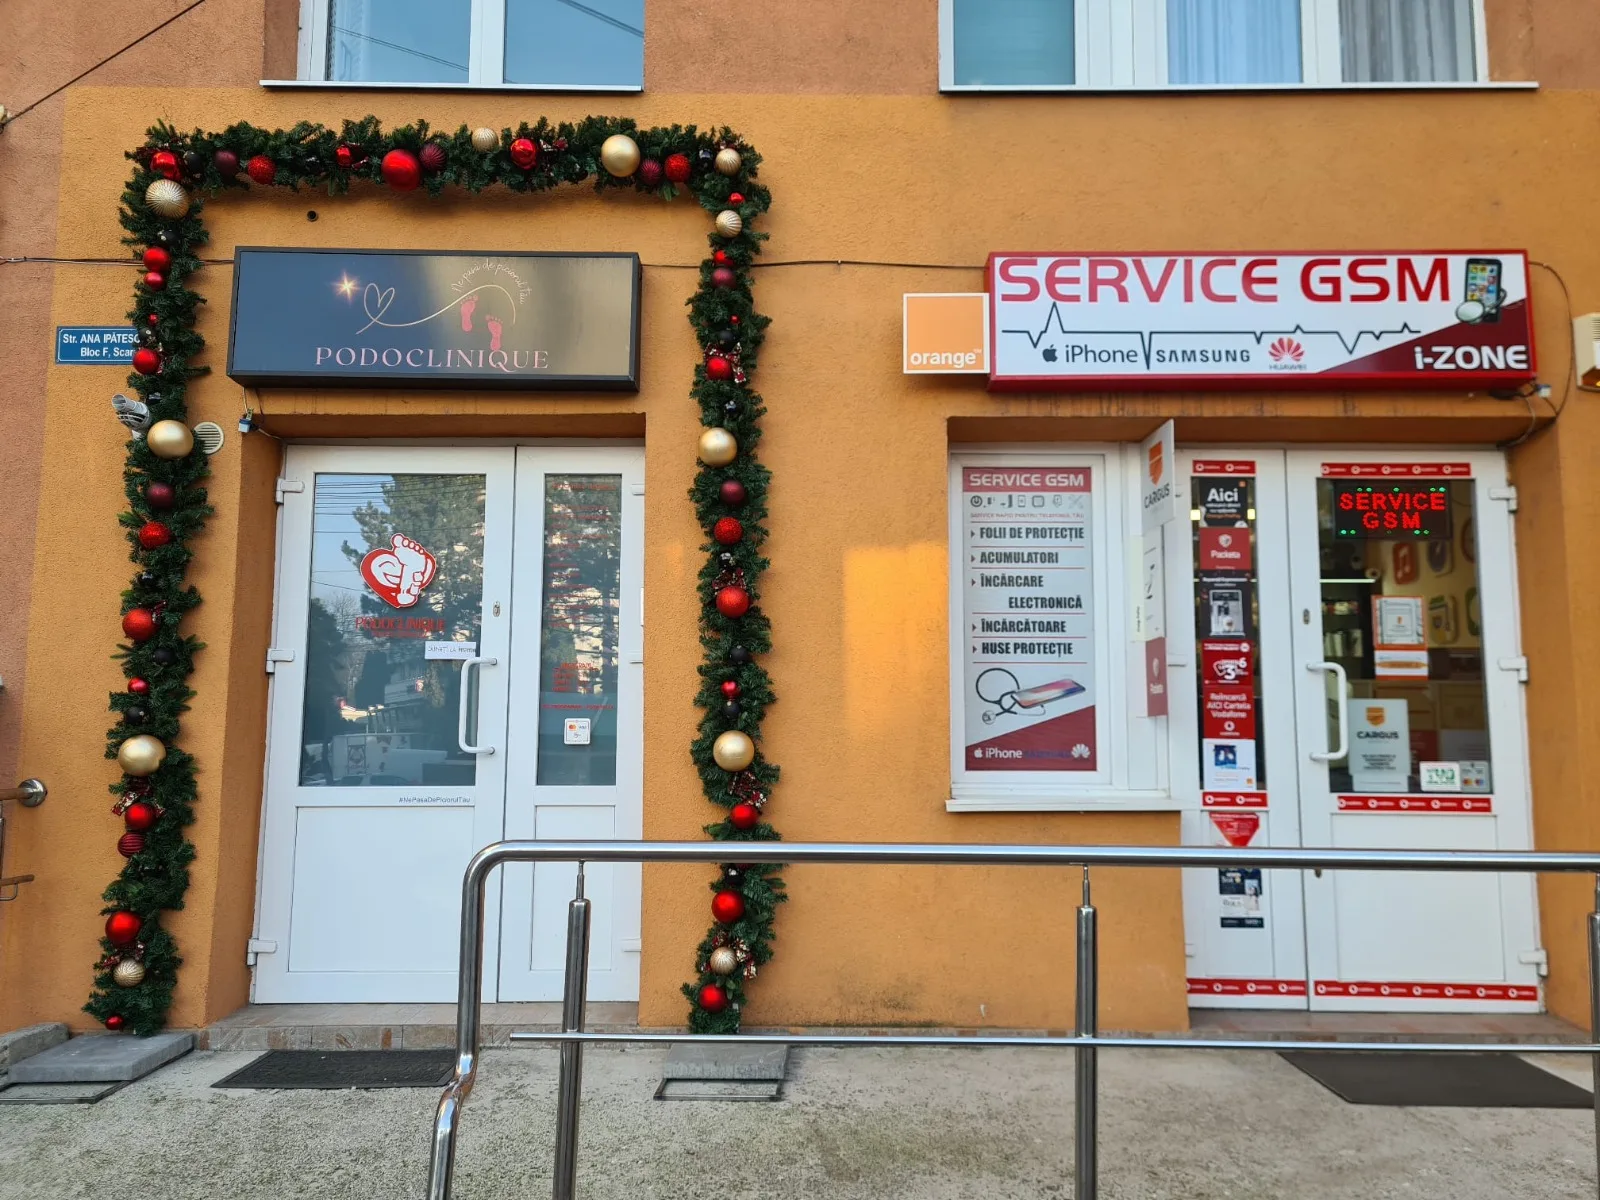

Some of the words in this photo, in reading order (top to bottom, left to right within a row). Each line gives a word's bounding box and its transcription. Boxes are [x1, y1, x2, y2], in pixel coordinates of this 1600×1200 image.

[1000, 258, 1278, 302] SERVICE
[1301, 258, 1450, 302] GSM
[62, 333, 78, 344] Str.
[80, 333, 101, 344] ANA
[80, 347, 101, 357] Bloc
[113, 347, 136, 358] Scar
[316, 346, 549, 373] PODOCLINIQUE
[910, 350, 976, 368] orange
[1065, 344, 1138, 363] iPhone
[1156, 349, 1250, 363] SAMSUNG
[1414, 345, 1528, 370] i-ZONE
[970, 473, 1041, 487] SERVICE
[1045, 473, 1084, 487] GSM
[1207, 487, 1239, 502] Aici
[1339, 492, 1446, 511] SERVICE
[1362, 511, 1421, 529] GSM
[980, 527, 1006, 539] FOLII
[1009, 527, 1023, 539] DE
[1025, 527, 1085, 541] PROTECȚIE
[980, 552, 1059, 564] ACUMULATORI
[1008, 595, 1083, 609] ELECTRONICĂ
[981, 642, 1011, 655] HUSE
[1013, 642, 1073, 658] PROTECȚIE
[1356, 730, 1399, 740] CARGUS
[985, 747, 1022, 759] iPhone
